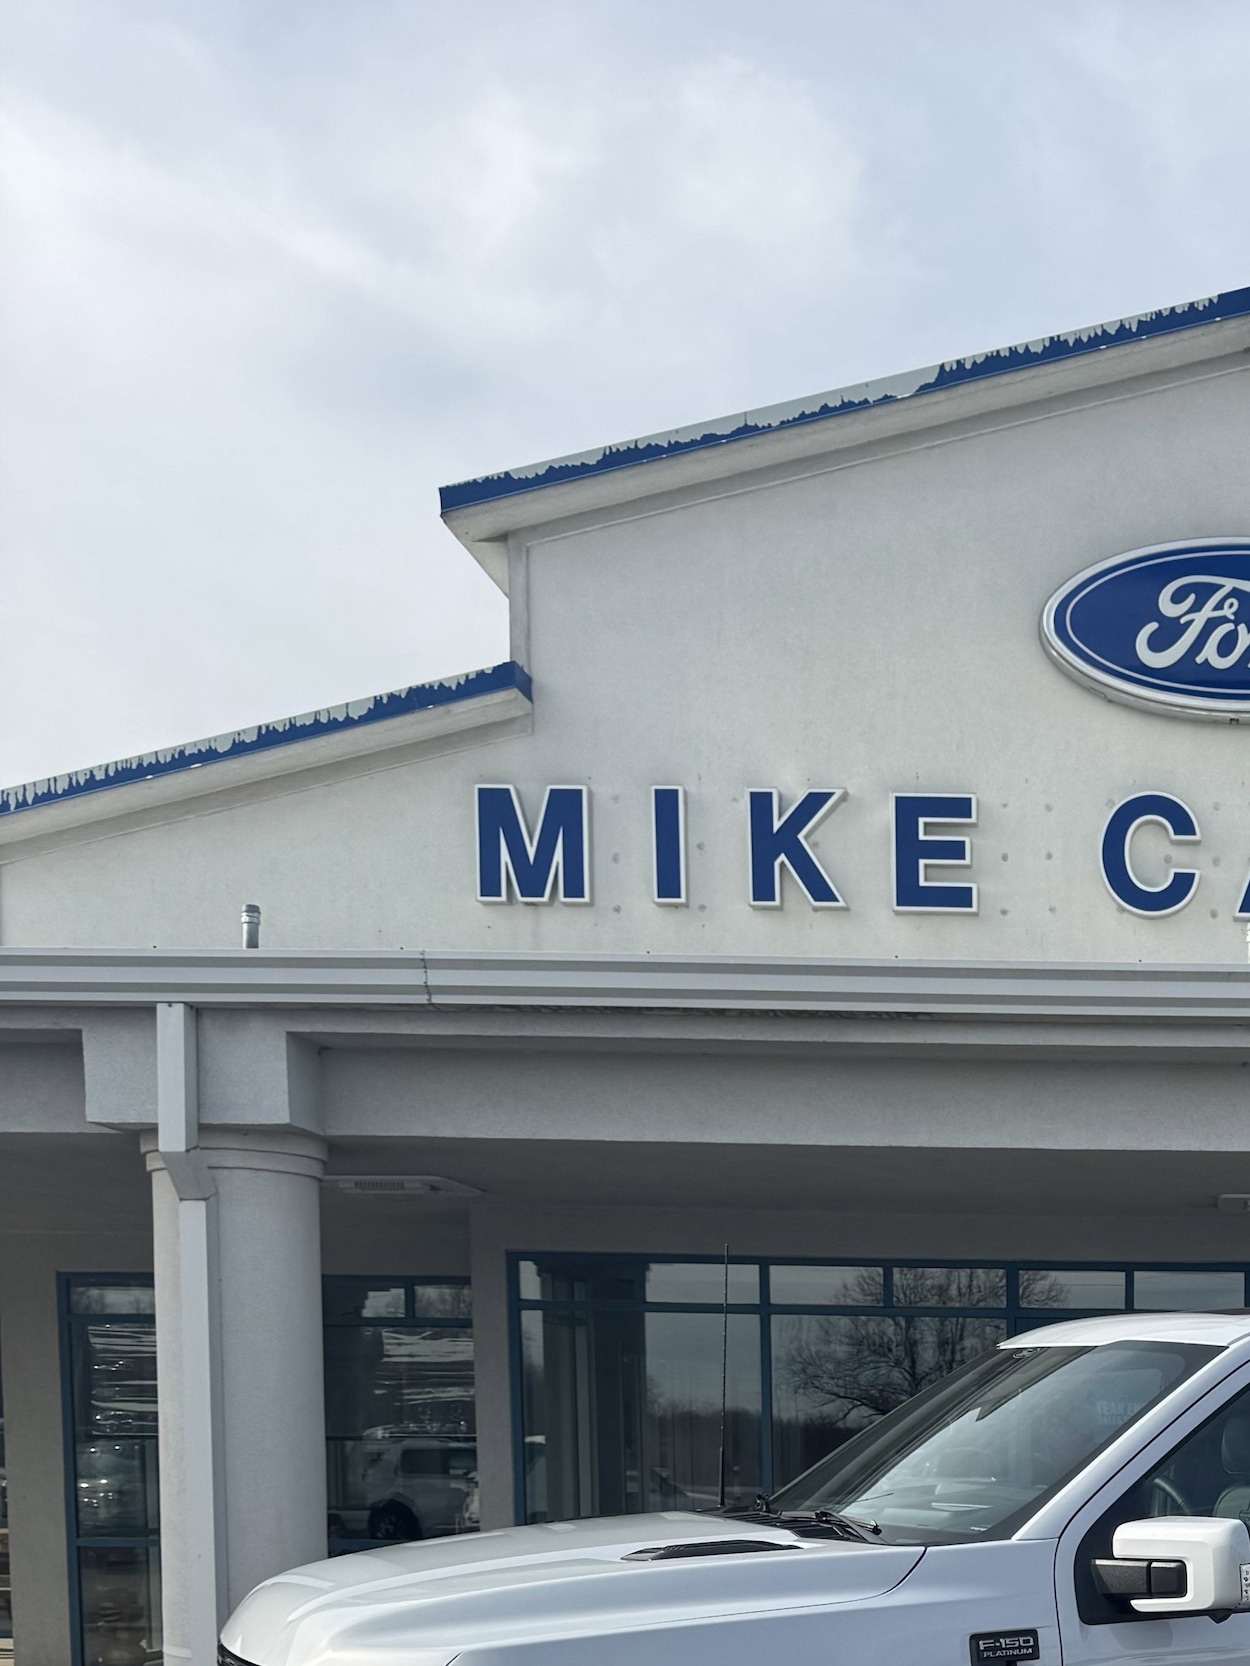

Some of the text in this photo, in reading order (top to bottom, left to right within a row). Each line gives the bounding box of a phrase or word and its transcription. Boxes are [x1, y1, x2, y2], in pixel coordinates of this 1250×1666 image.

[475, 784, 978, 912] MIKE
[979, 1636, 1034, 1650] F-150
[983, 1648, 1032, 1657] PLATINUM
